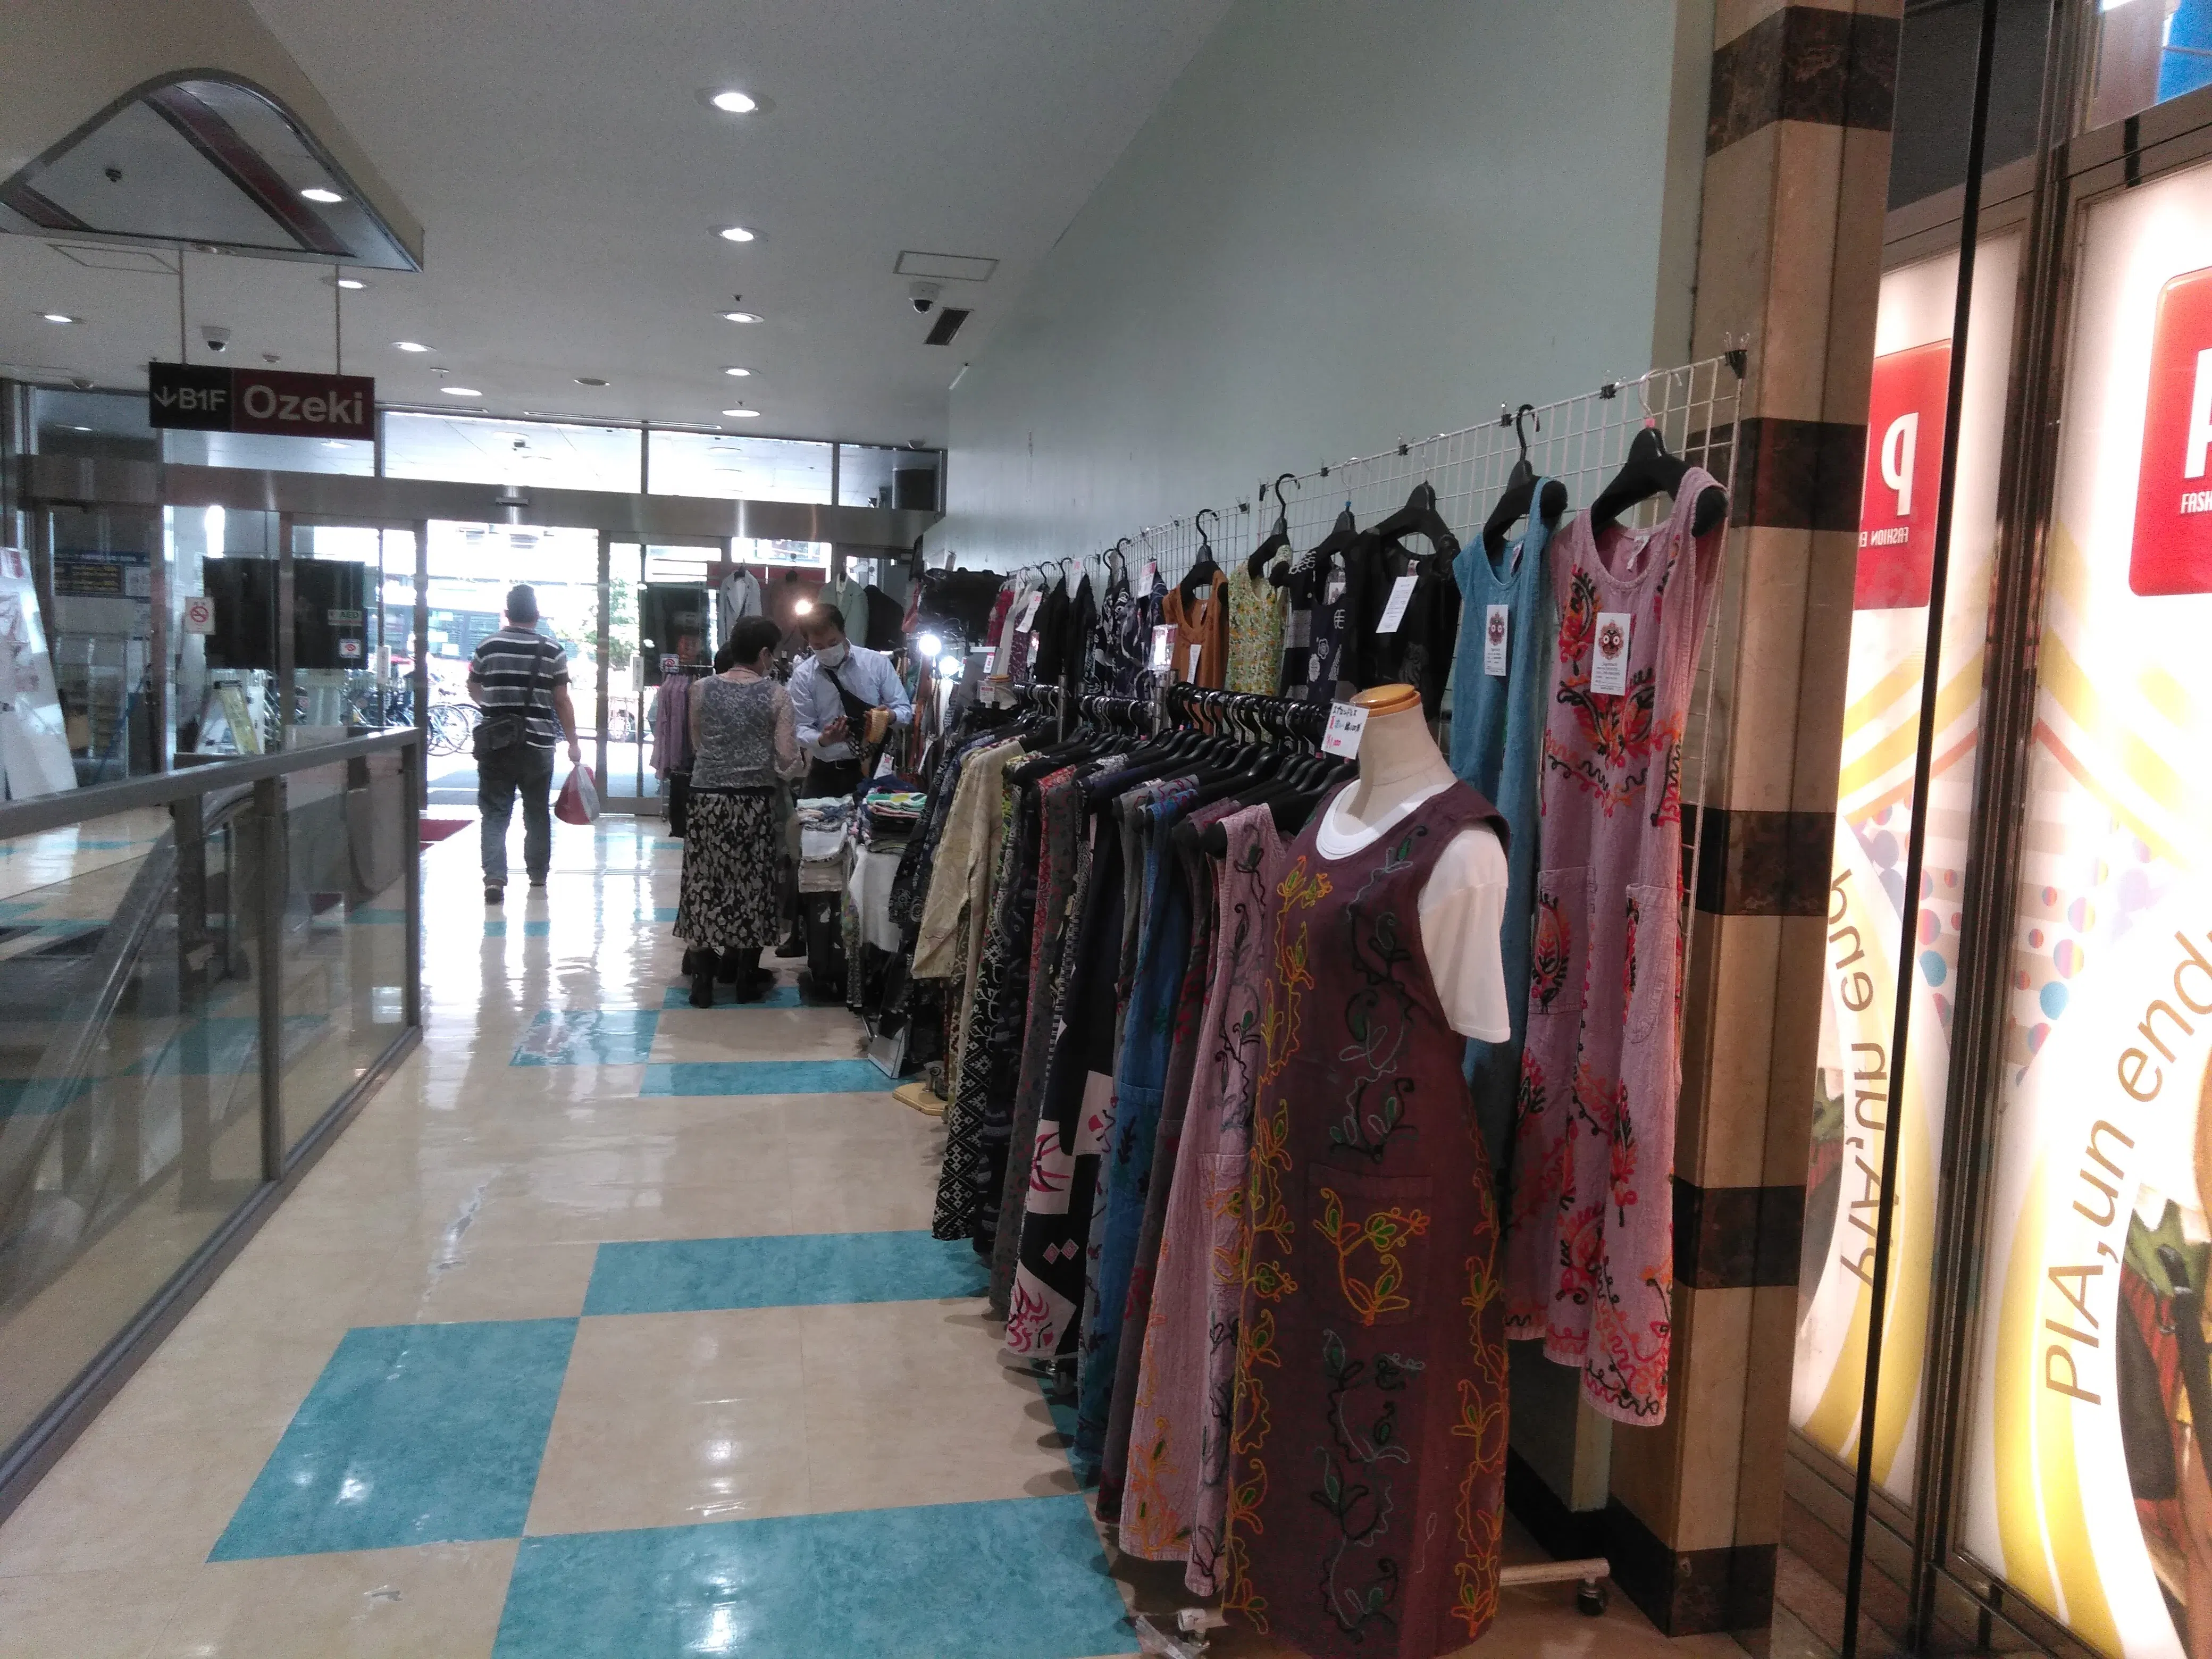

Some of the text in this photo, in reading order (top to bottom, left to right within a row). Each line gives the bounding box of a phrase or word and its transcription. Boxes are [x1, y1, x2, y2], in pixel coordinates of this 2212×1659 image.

[179, 384, 363, 424] B1F Ozeki
[2117, 930, 2212, 1102] end
